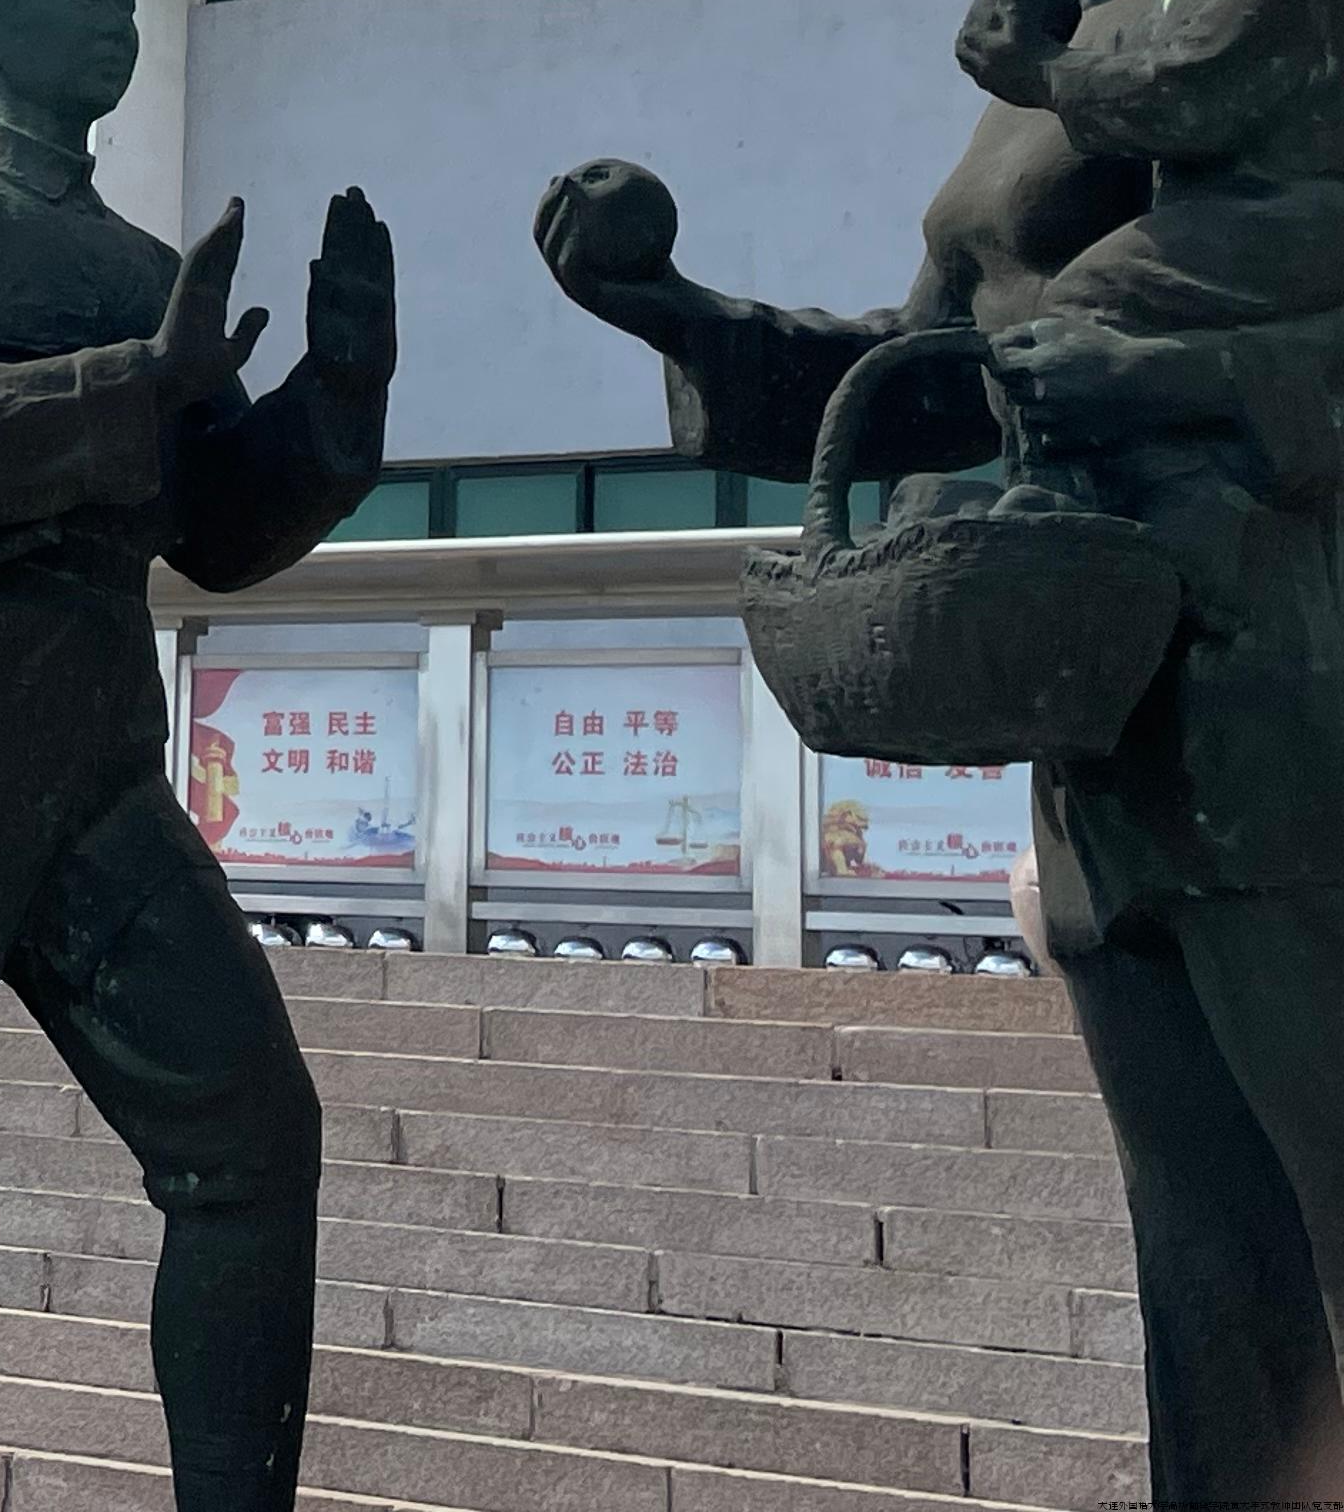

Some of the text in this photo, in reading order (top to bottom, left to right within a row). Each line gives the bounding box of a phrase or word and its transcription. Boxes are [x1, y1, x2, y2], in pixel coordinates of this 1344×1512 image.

[263, 711, 377, 737] 富强 民主
[554, 709, 679, 737] 自由 平等
[262, 748, 377, 775] 文明 和谐
[552, 750, 679, 777] 公正 法治
